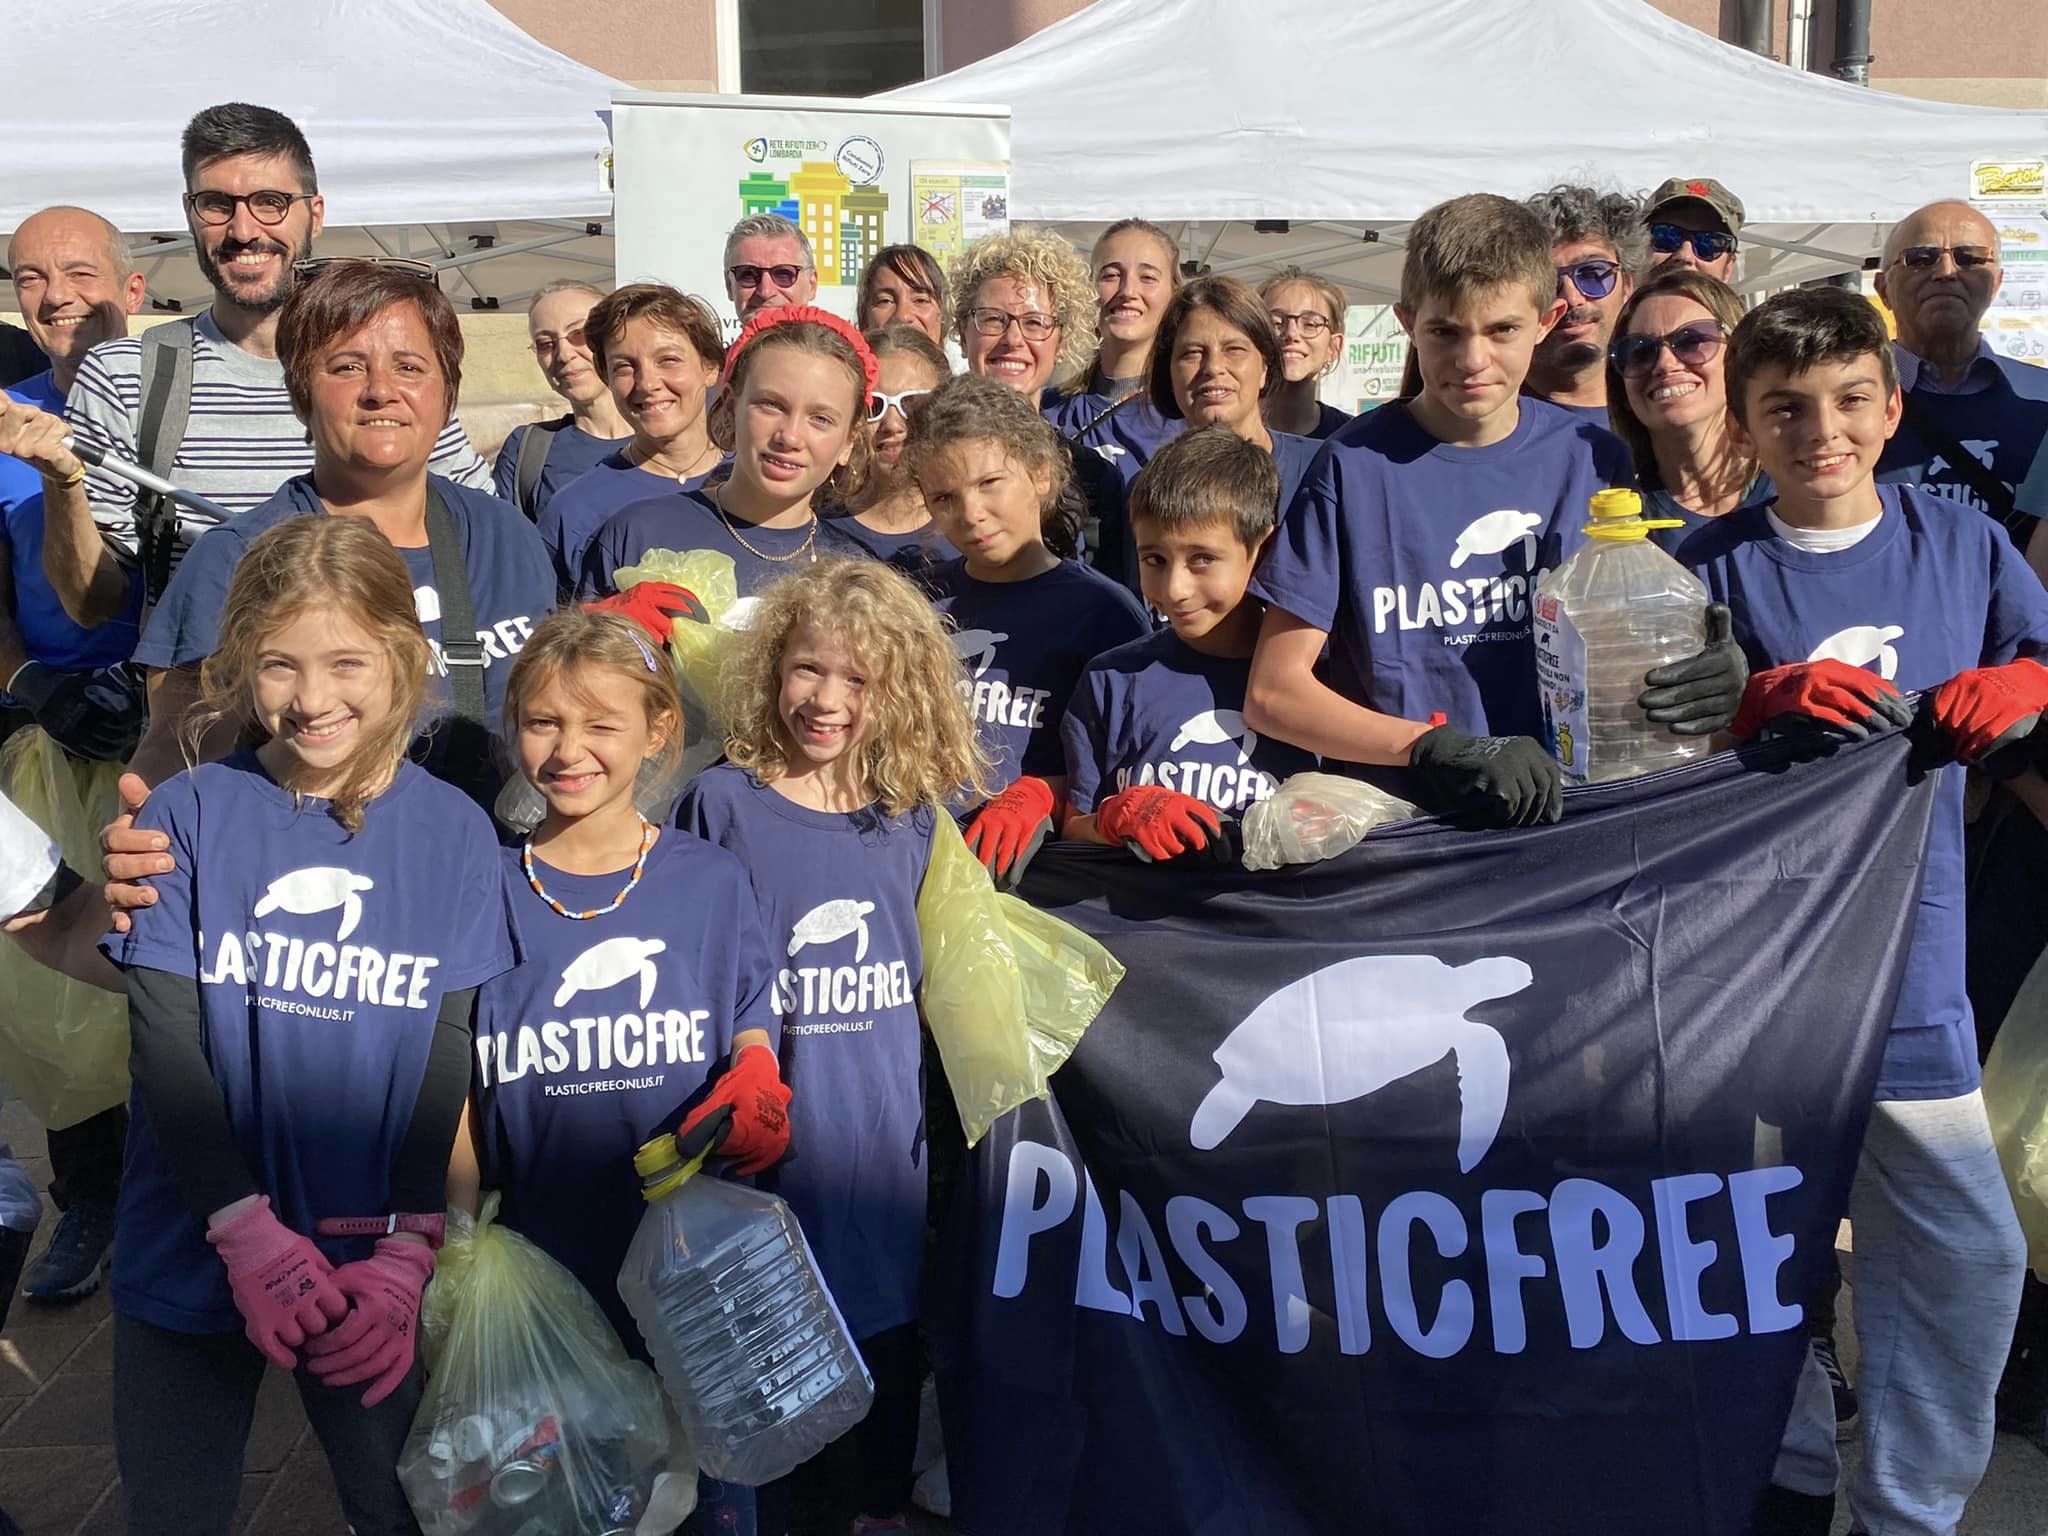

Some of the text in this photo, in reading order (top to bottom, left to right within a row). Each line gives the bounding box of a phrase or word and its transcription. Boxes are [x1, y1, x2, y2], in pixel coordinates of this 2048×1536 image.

[770, 140, 784, 149] RETE
[785, 140, 805, 150] RIFIUTI
[770, 149, 803, 159] LOMBARDIA
[1373, 575, 1538, 633] PLASTIC
[198, 930, 440, 1009] LASTICFREE
[476, 1009, 711, 1089] PLASTICFRE
[544, 1075, 665, 1097] PLASTICFREEONLUS.IT
[993, 1140, 1803, 1360] PLASTICFREE
